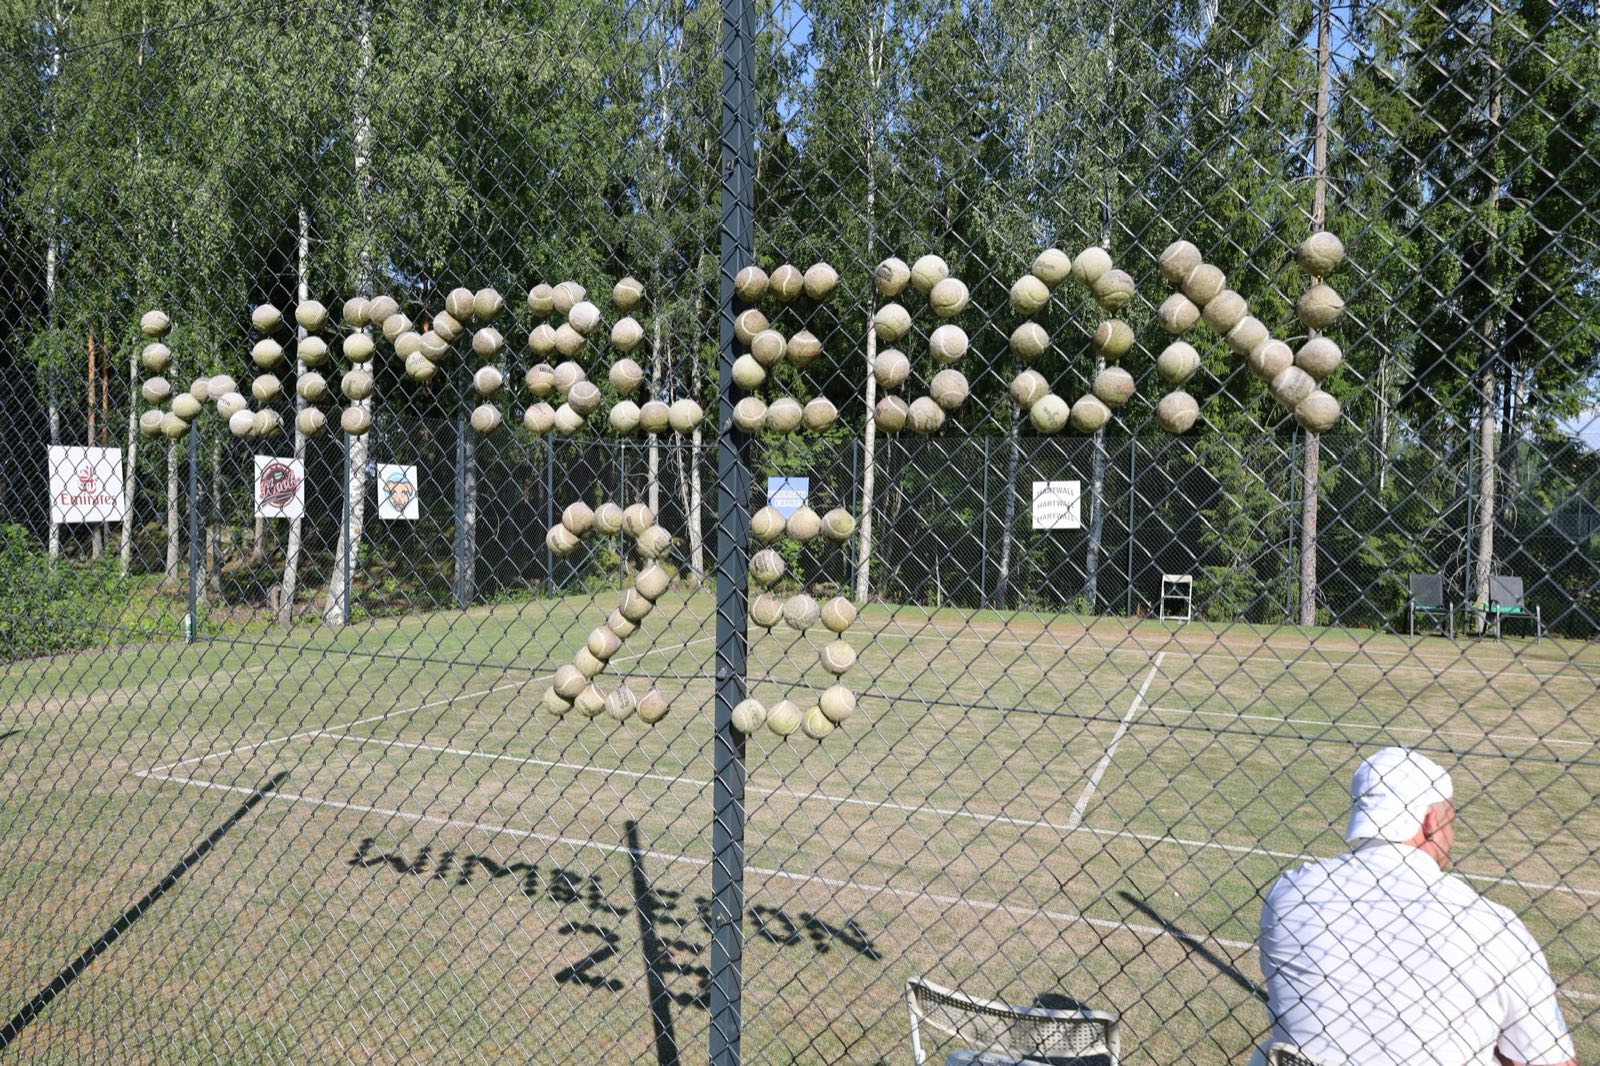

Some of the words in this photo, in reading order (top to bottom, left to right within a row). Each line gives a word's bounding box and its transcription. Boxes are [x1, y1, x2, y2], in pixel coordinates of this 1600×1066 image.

[139, 231, 1345, 437] WIMBLEDON
[60, 492, 117, 506] Emirates
[544, 501, 857, 740] 25
